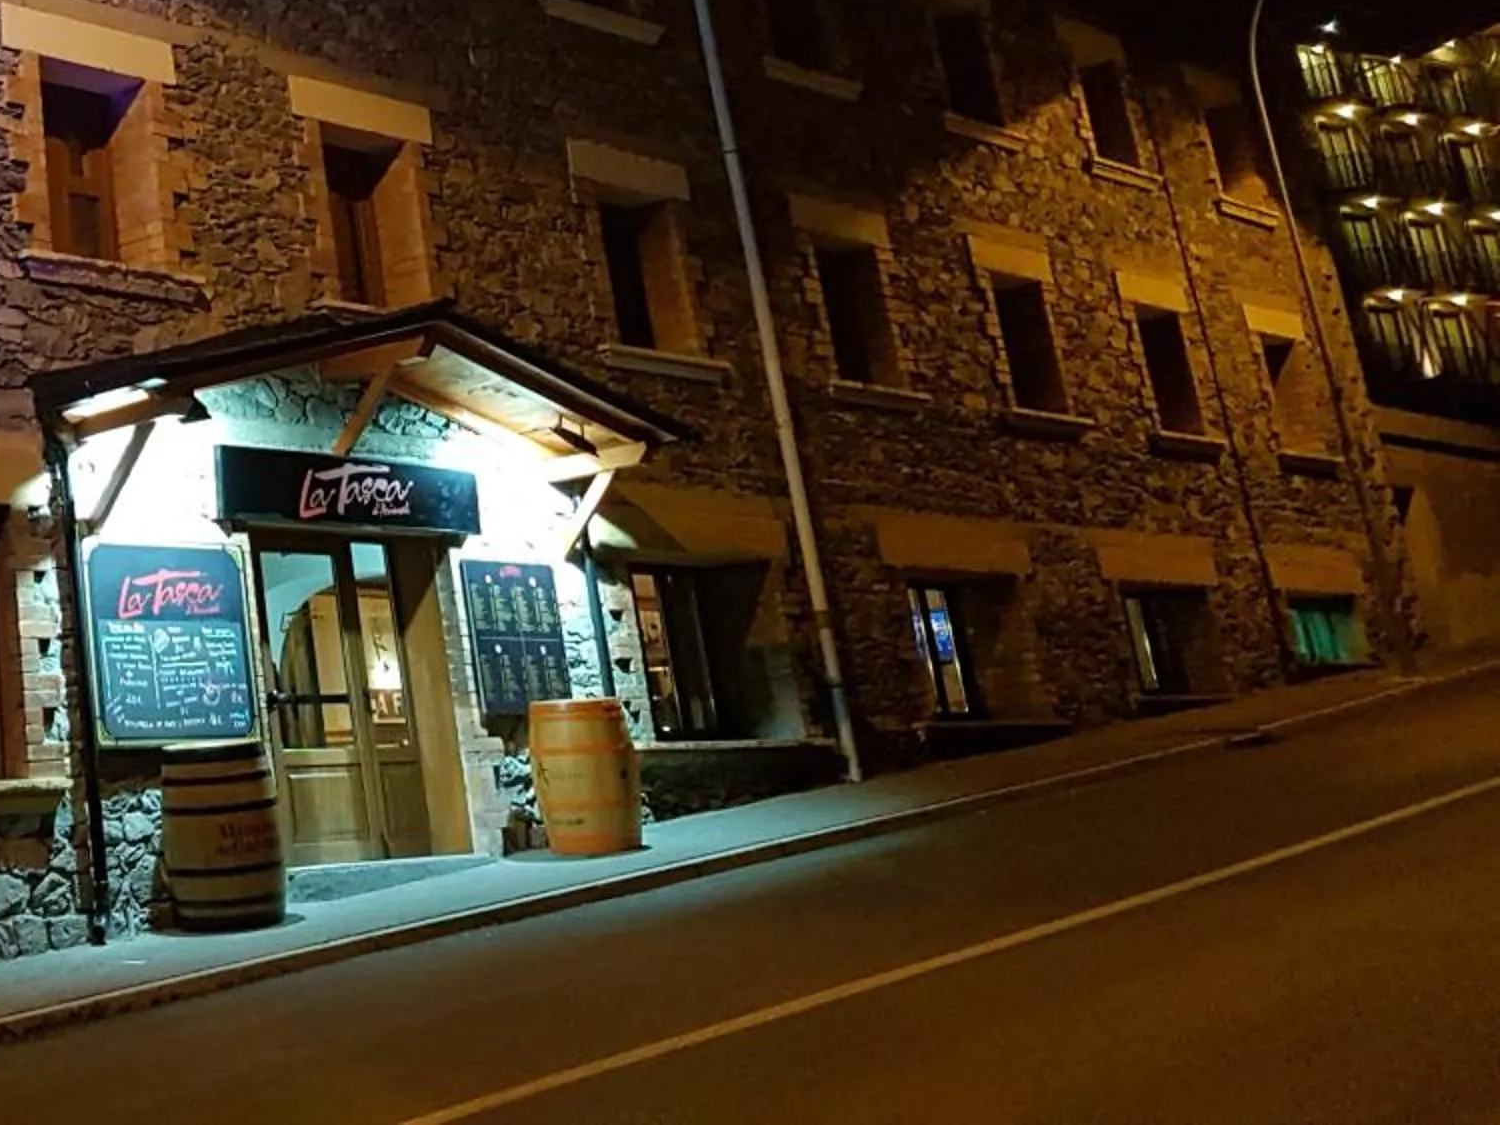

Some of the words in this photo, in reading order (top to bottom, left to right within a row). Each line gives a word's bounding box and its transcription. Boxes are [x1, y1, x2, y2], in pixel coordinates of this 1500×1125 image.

[300, 468, 336, 519] La
[314, 462, 414, 516] Tasca
[118, 576, 152, 619] La
[131, 569, 225, 616] Tasca
